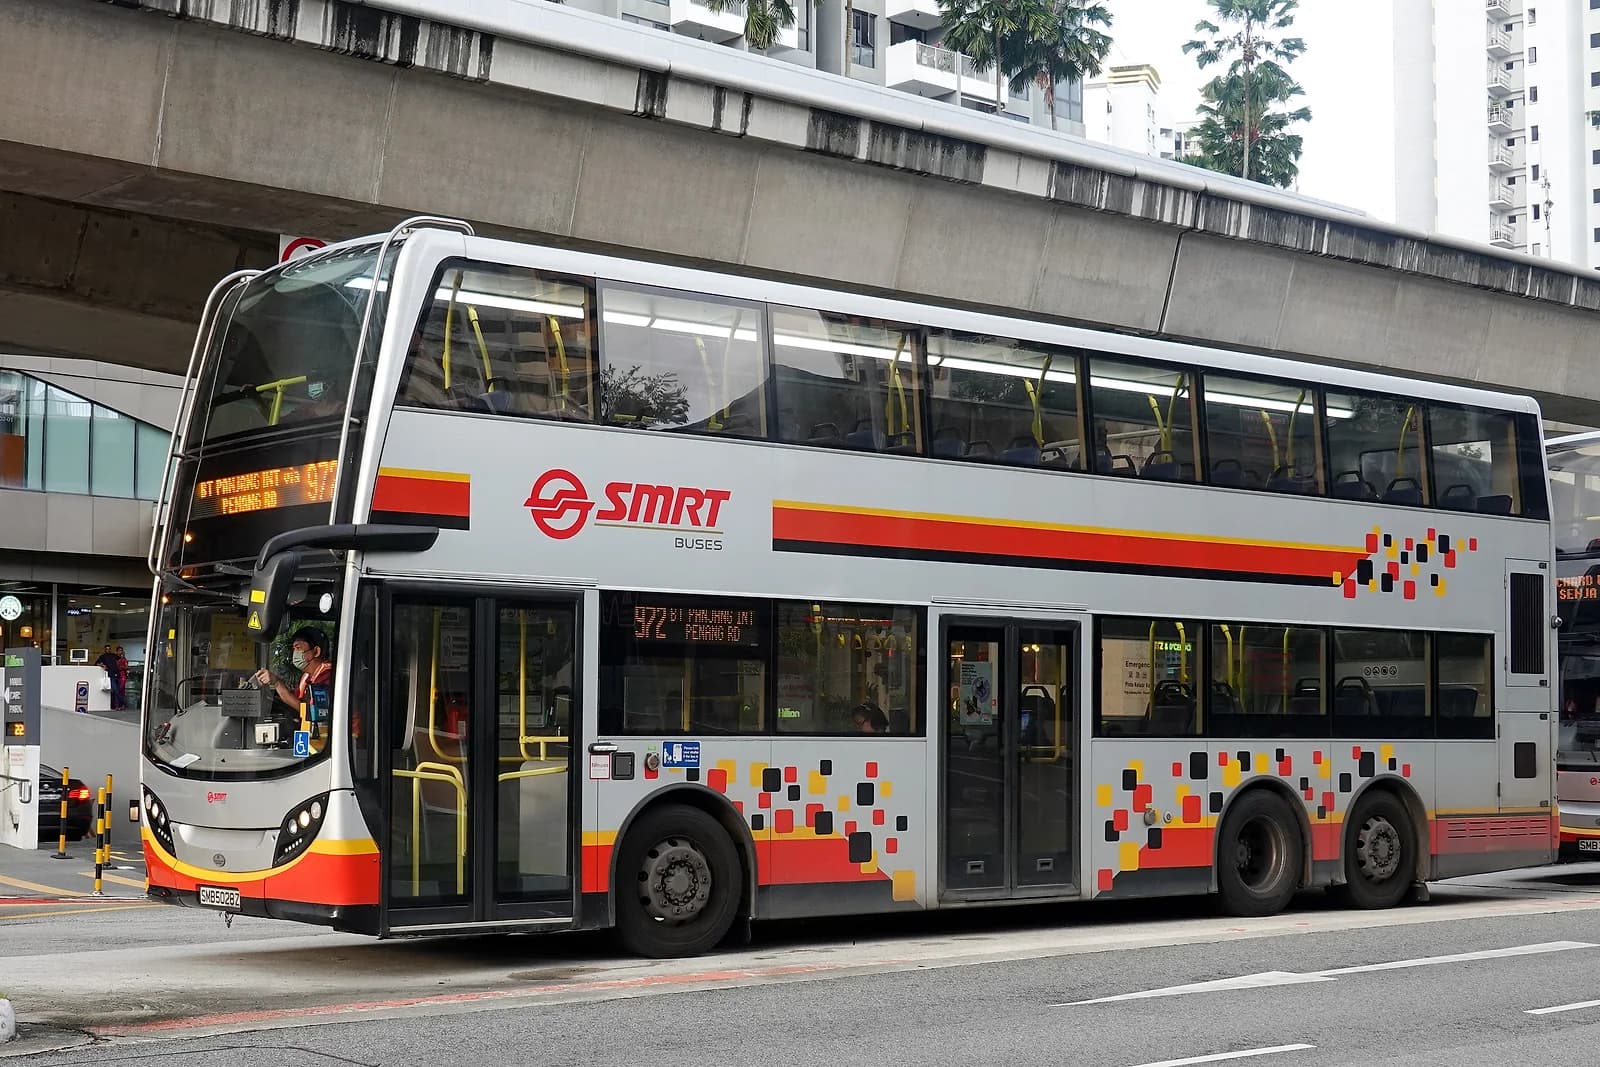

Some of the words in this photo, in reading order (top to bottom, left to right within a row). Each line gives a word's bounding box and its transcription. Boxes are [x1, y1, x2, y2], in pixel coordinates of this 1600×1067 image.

[200, 481, 214, 498] BT
[216, 472, 260, 496] PANJANG
[262, 469, 280, 489] INT
[222, 493, 261, 514] PENANG
[263, 490, 278, 508] RD
[596, 481, 731, 527] SMRT
[674, 537, 723, 551] BUSES
[1560, 588, 1597, 600] SENJA
[634, 606, 667, 639] 972
[670, 608, 683, 622] BT
[688, 608, 733, 625] PANJANG
[685, 624, 724, 641] PENANG
[727, 626, 741, 642] RD
[1125, 660, 1152, 669] Emergenc
[14, 723, 25, 736] 22
[201, 889, 240, 907] SMB5028Z
